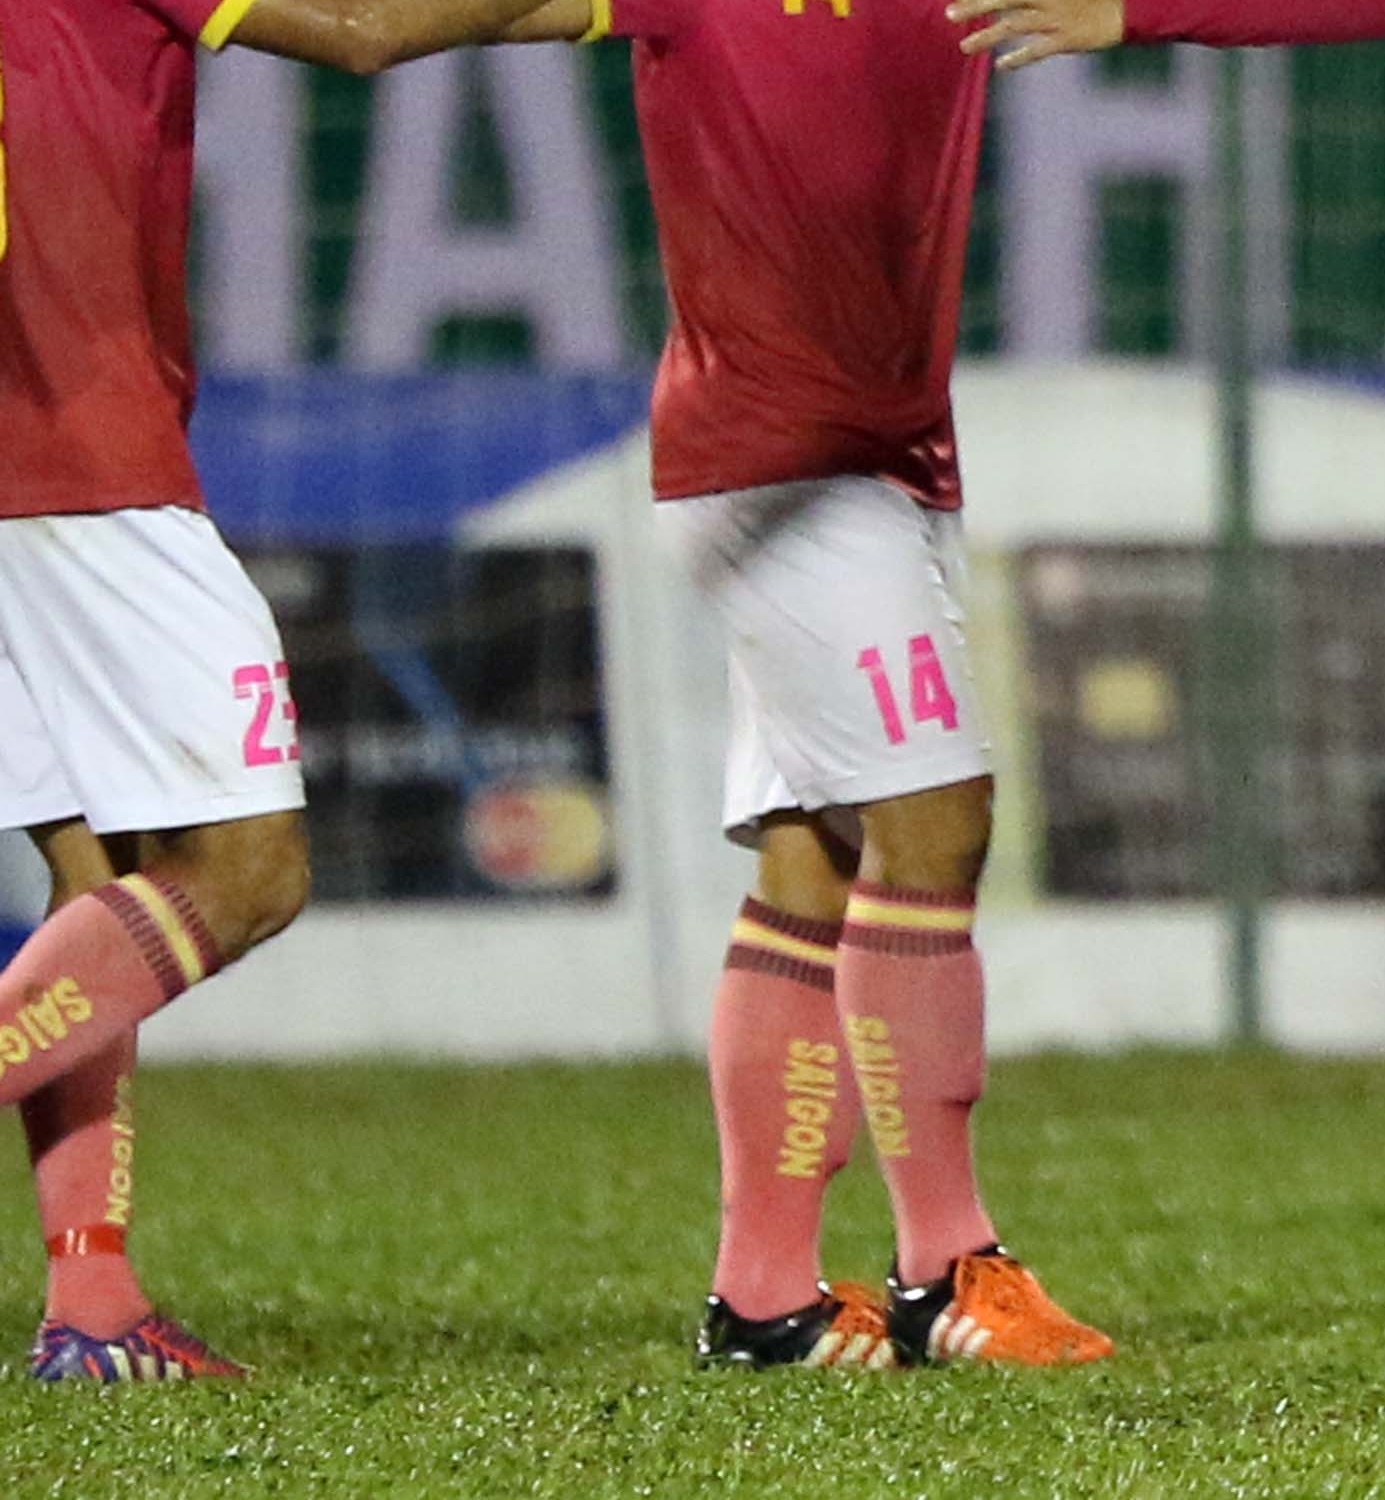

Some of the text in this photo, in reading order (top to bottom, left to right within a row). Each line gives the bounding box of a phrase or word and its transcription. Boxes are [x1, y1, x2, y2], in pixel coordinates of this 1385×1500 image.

[857, 633, 958, 746] 14
[0, 976, 93, 1078] SAIG
[846, 1013, 911, 1157] SAIGON
[776, 1038, 839, 1179] SAIGON
